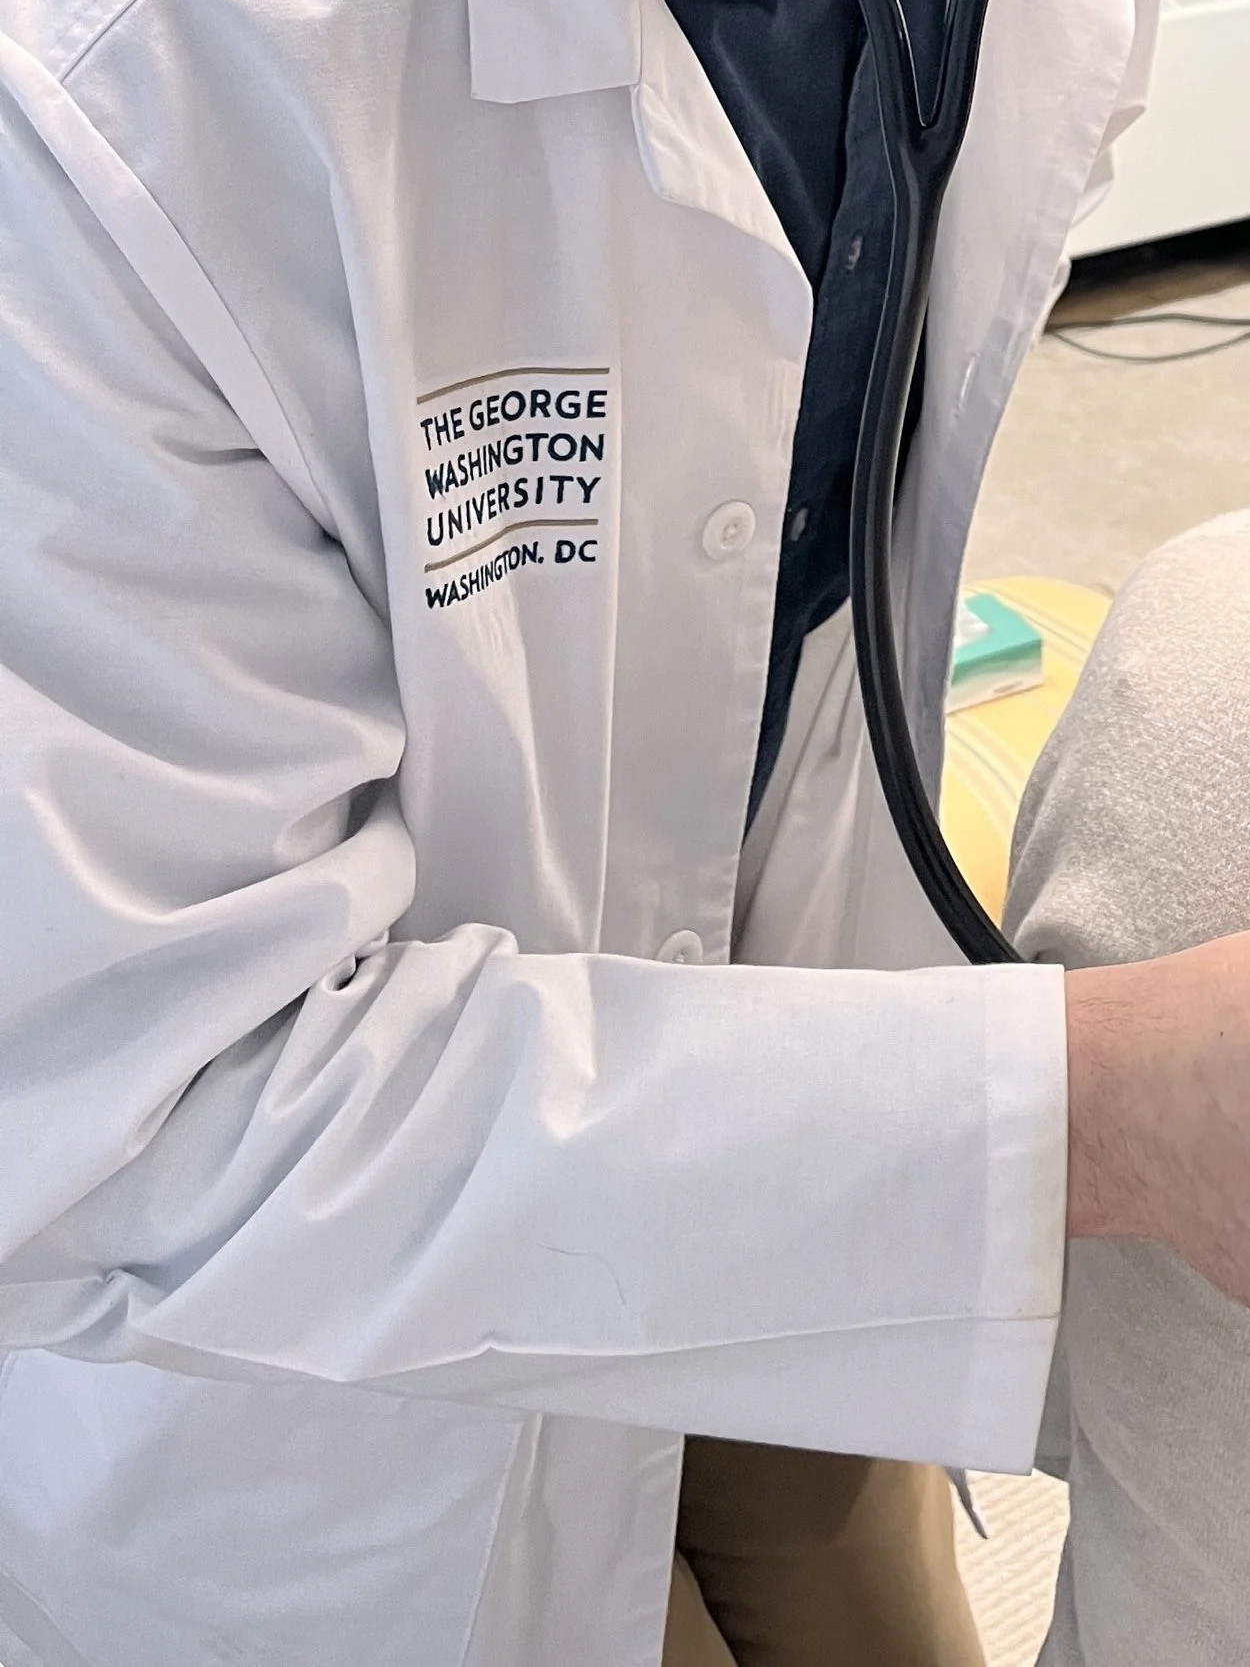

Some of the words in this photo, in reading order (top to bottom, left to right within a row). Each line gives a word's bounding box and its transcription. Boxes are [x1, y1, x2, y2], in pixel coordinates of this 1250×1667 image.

[420, 406, 465, 451] THE
[469, 389, 607, 431] GEORGE
[425, 433, 604, 499] WASHINGTON
[427, 475, 601, 546] UNIVERSITY
[555, 540, 597, 563] DC
